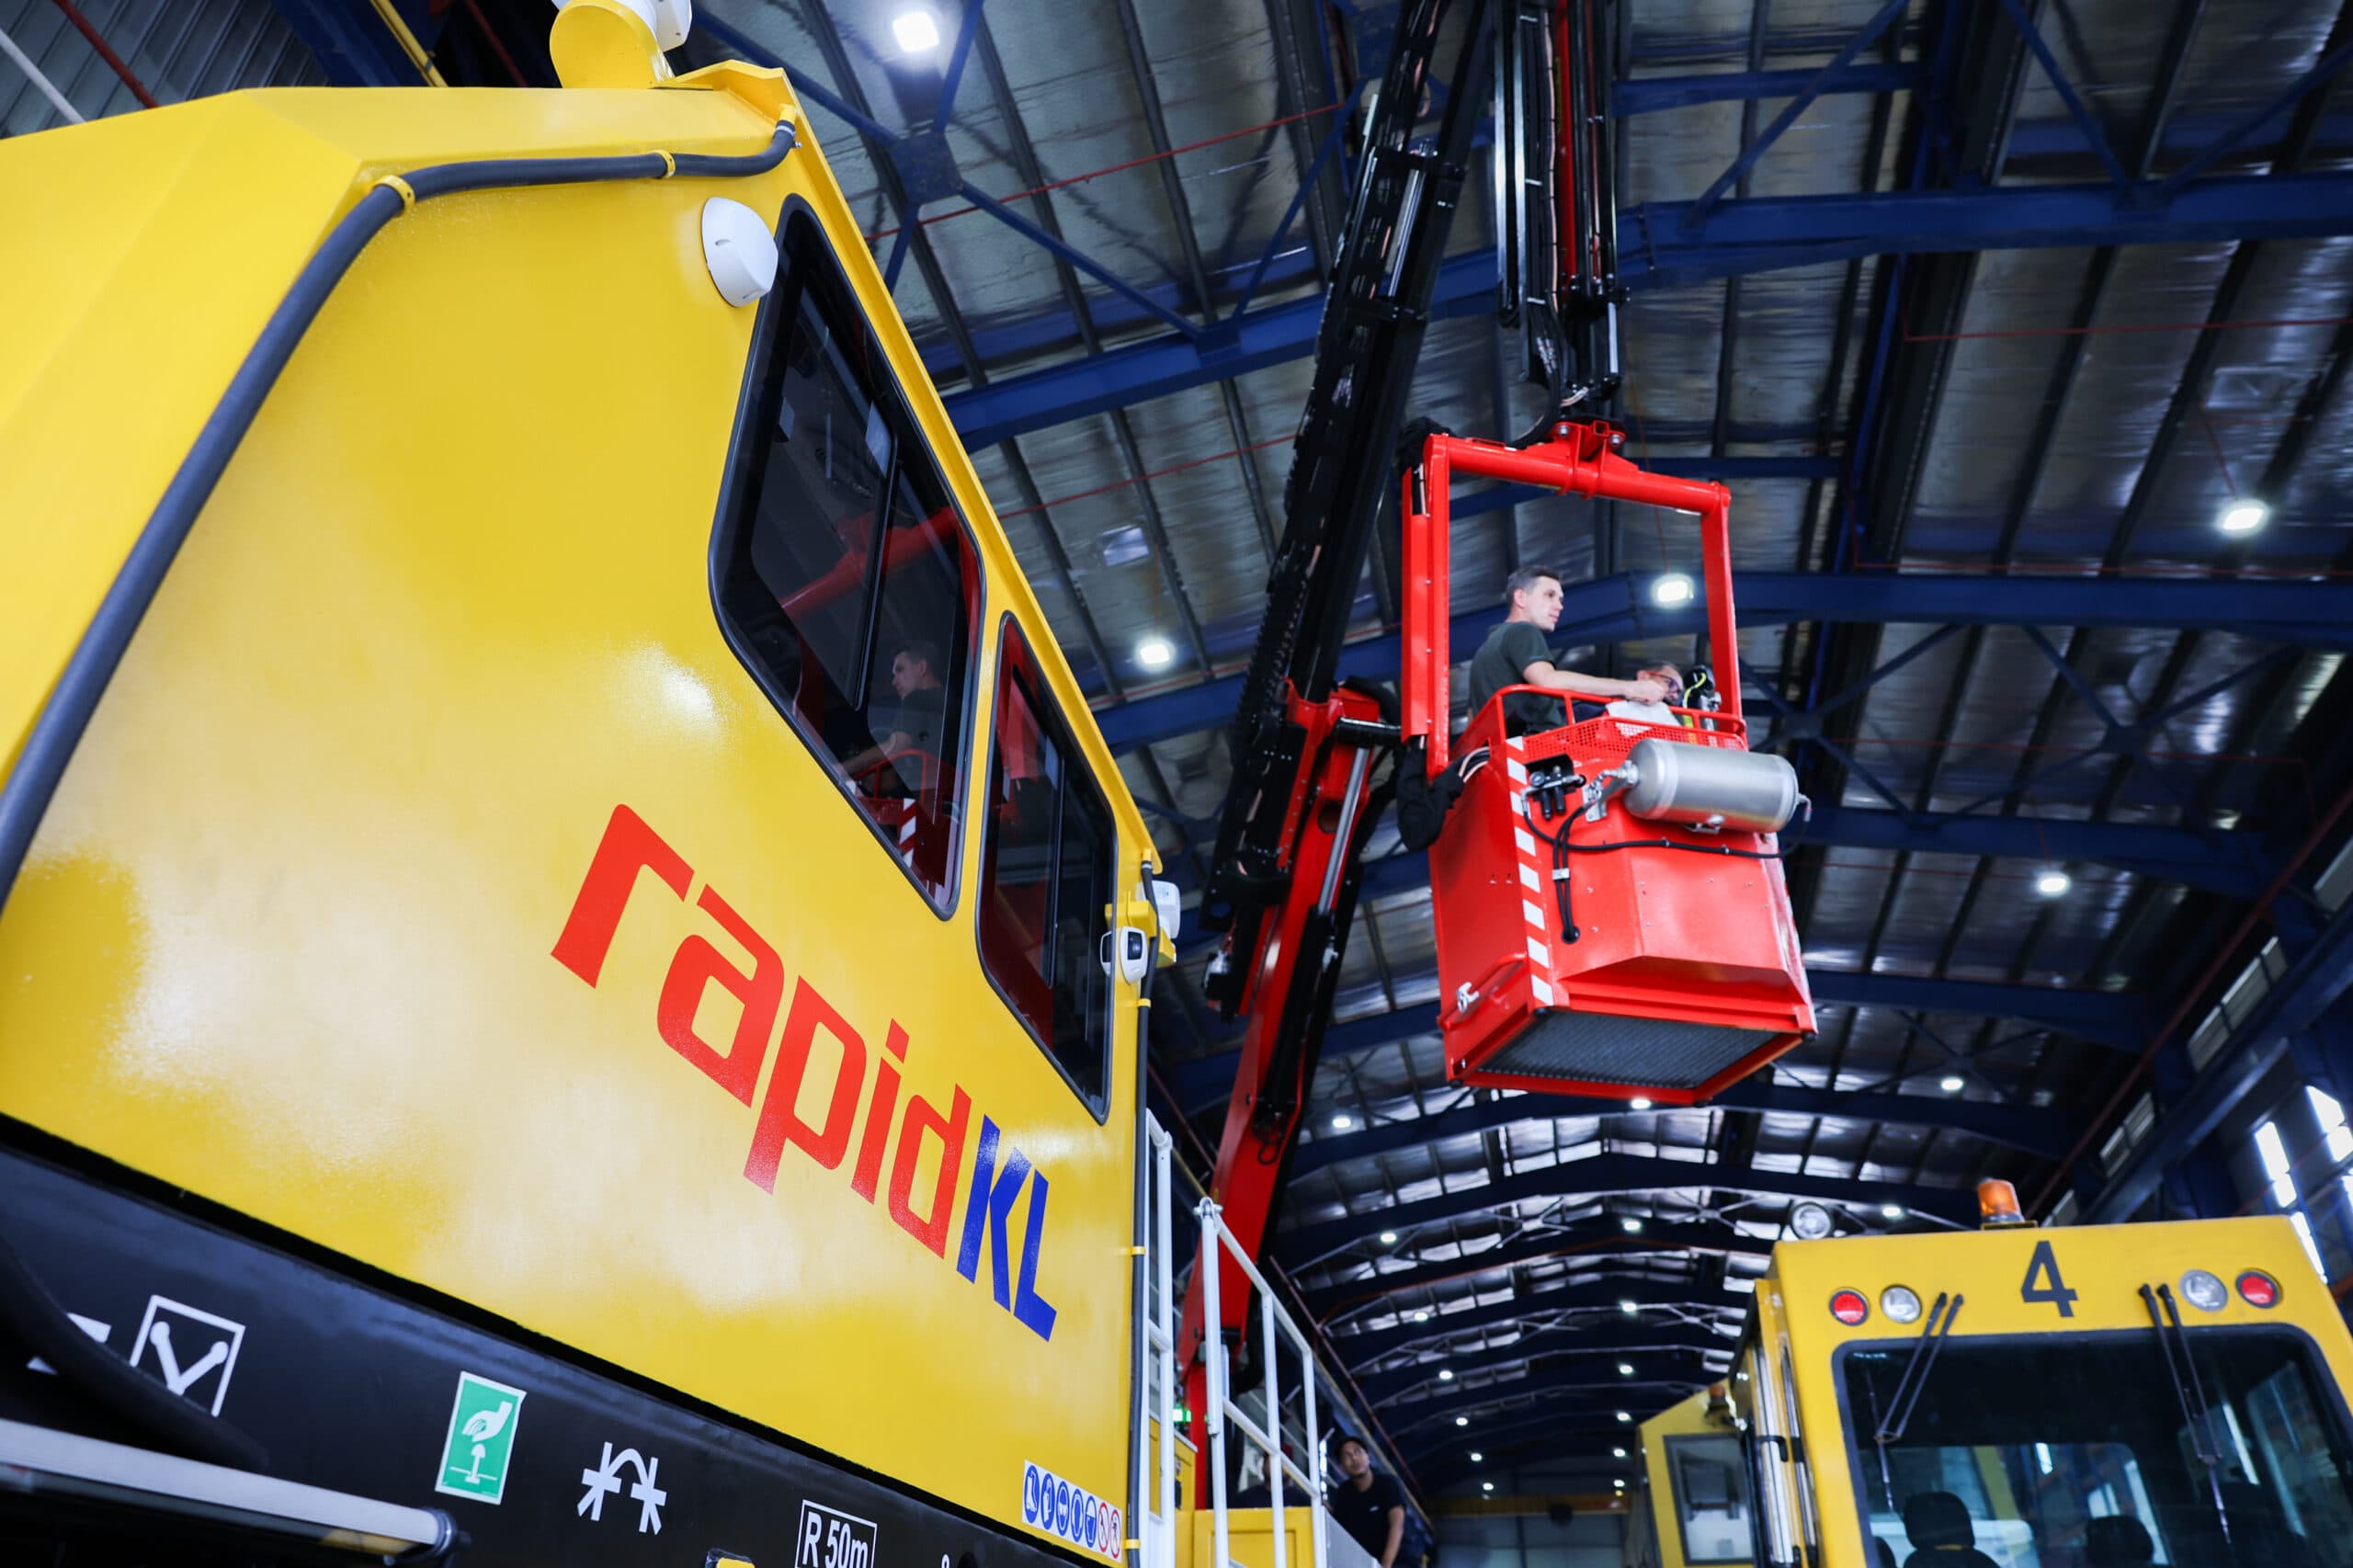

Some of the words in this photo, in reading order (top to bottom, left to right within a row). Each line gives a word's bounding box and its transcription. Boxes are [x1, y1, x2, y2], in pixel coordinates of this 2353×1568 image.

[551, 803, 1057, 1343] rapidKL
[2020, 1240, 2078, 1318] 4
[801, 1511, 823, 1568] R
[824, 1518, 869, 1568] 50m
